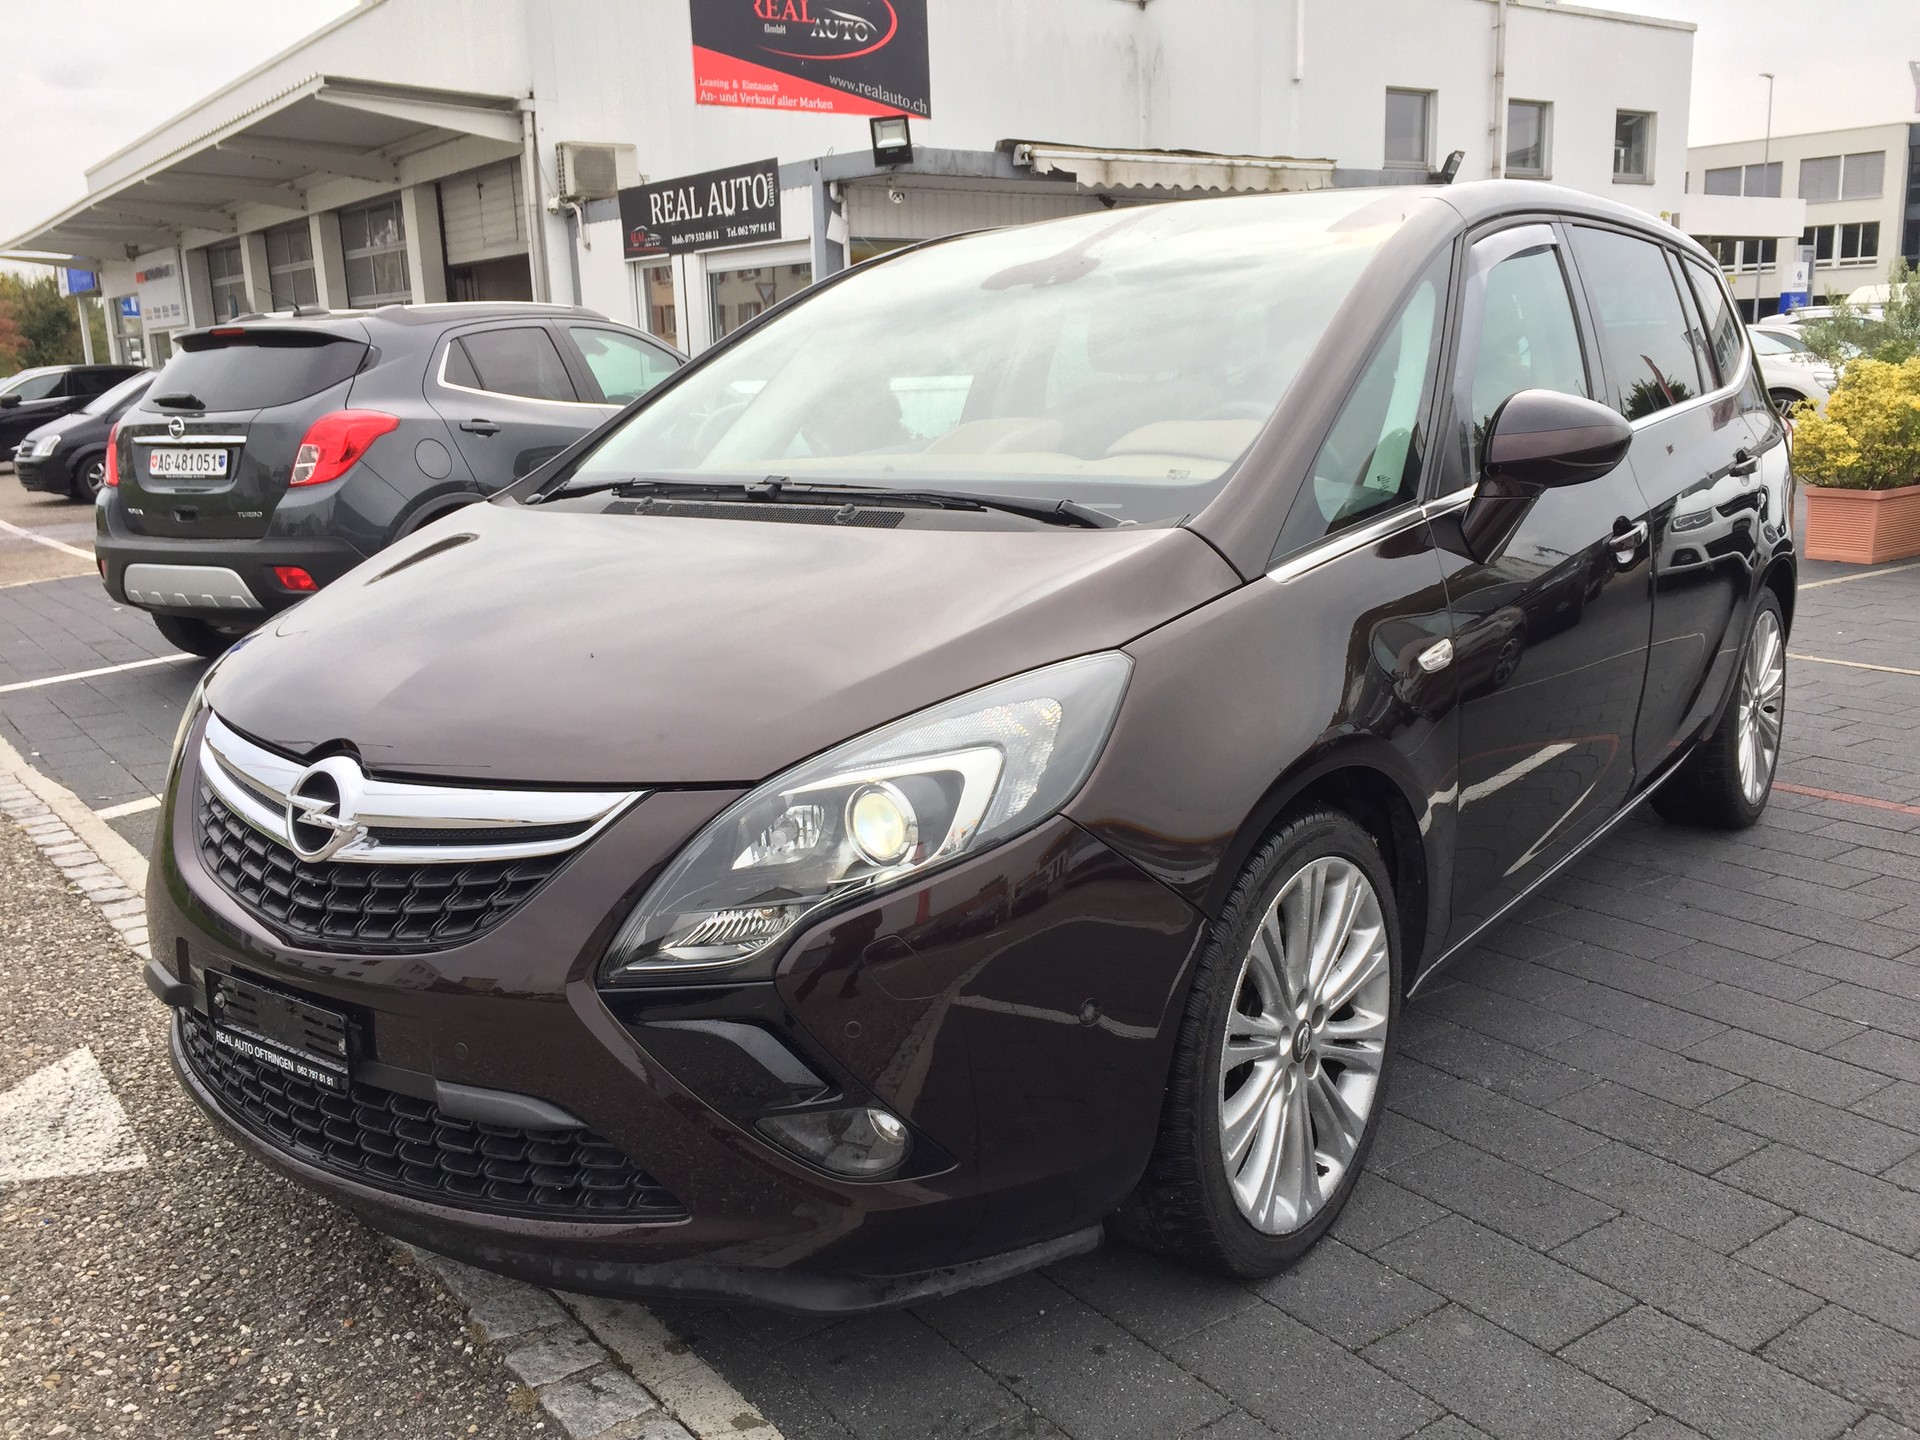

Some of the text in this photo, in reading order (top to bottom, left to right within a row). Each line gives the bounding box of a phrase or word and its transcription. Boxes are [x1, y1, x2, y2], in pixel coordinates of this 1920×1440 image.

[764, 23, 786, 34] GmbH
[810, 18, 869, 42] AUTO
[699, 77, 779, 92] Leasing & Eintausch
[829, 75, 928, 114] www.realauto.ch
[700, 90, 833, 109] An- und Verkauf aller Marken
[650, 172, 775, 225] REAL AUTO GmbH
[216, 1030, 334, 1087] REAL AUTO OFTRINGEN 062 797 81 81
